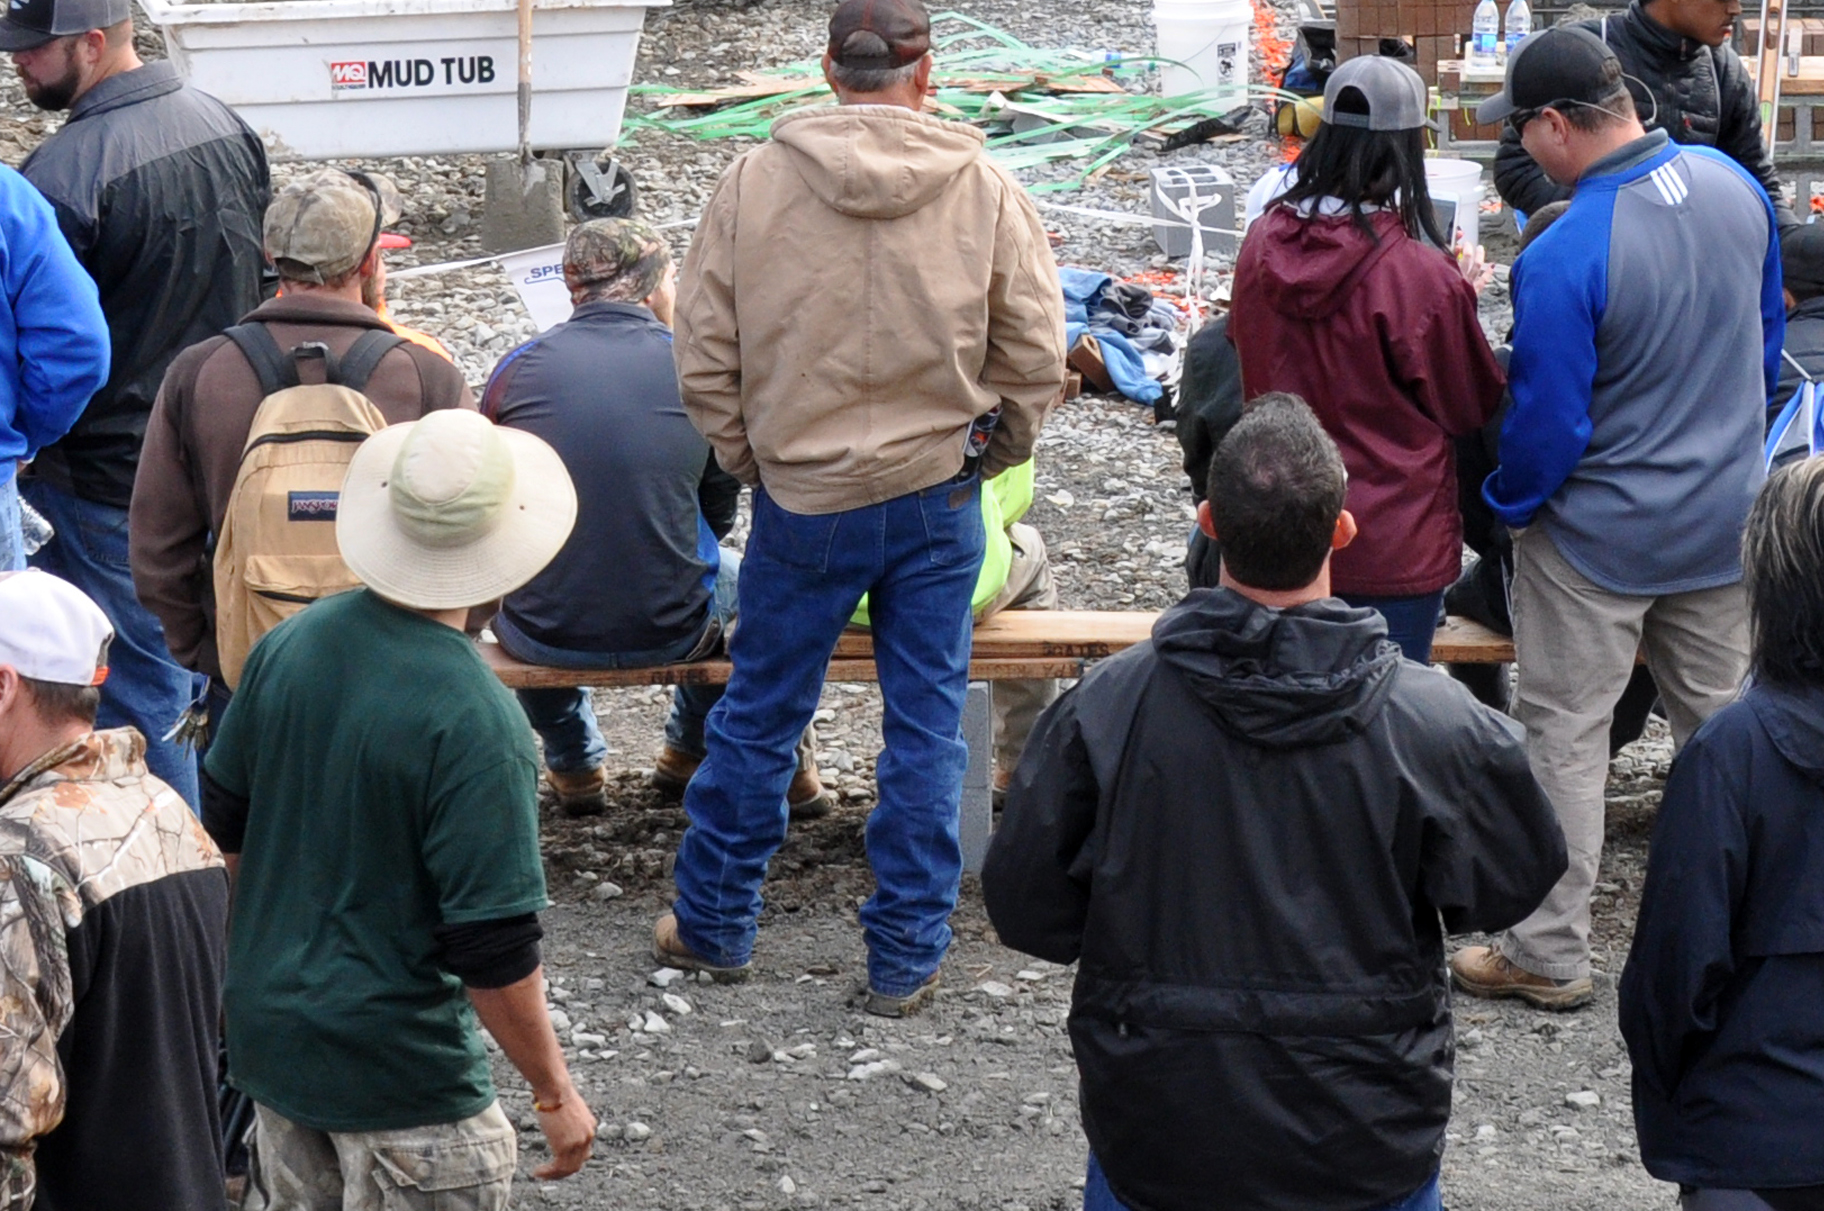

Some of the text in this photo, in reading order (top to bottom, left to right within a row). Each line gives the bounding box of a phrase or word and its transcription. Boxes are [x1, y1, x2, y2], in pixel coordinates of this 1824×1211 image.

[331, 56, 495, 89] MQ MUD TUB
[530, 263, 564, 278] SPE
[291, 499, 339, 514] JANSPOR
